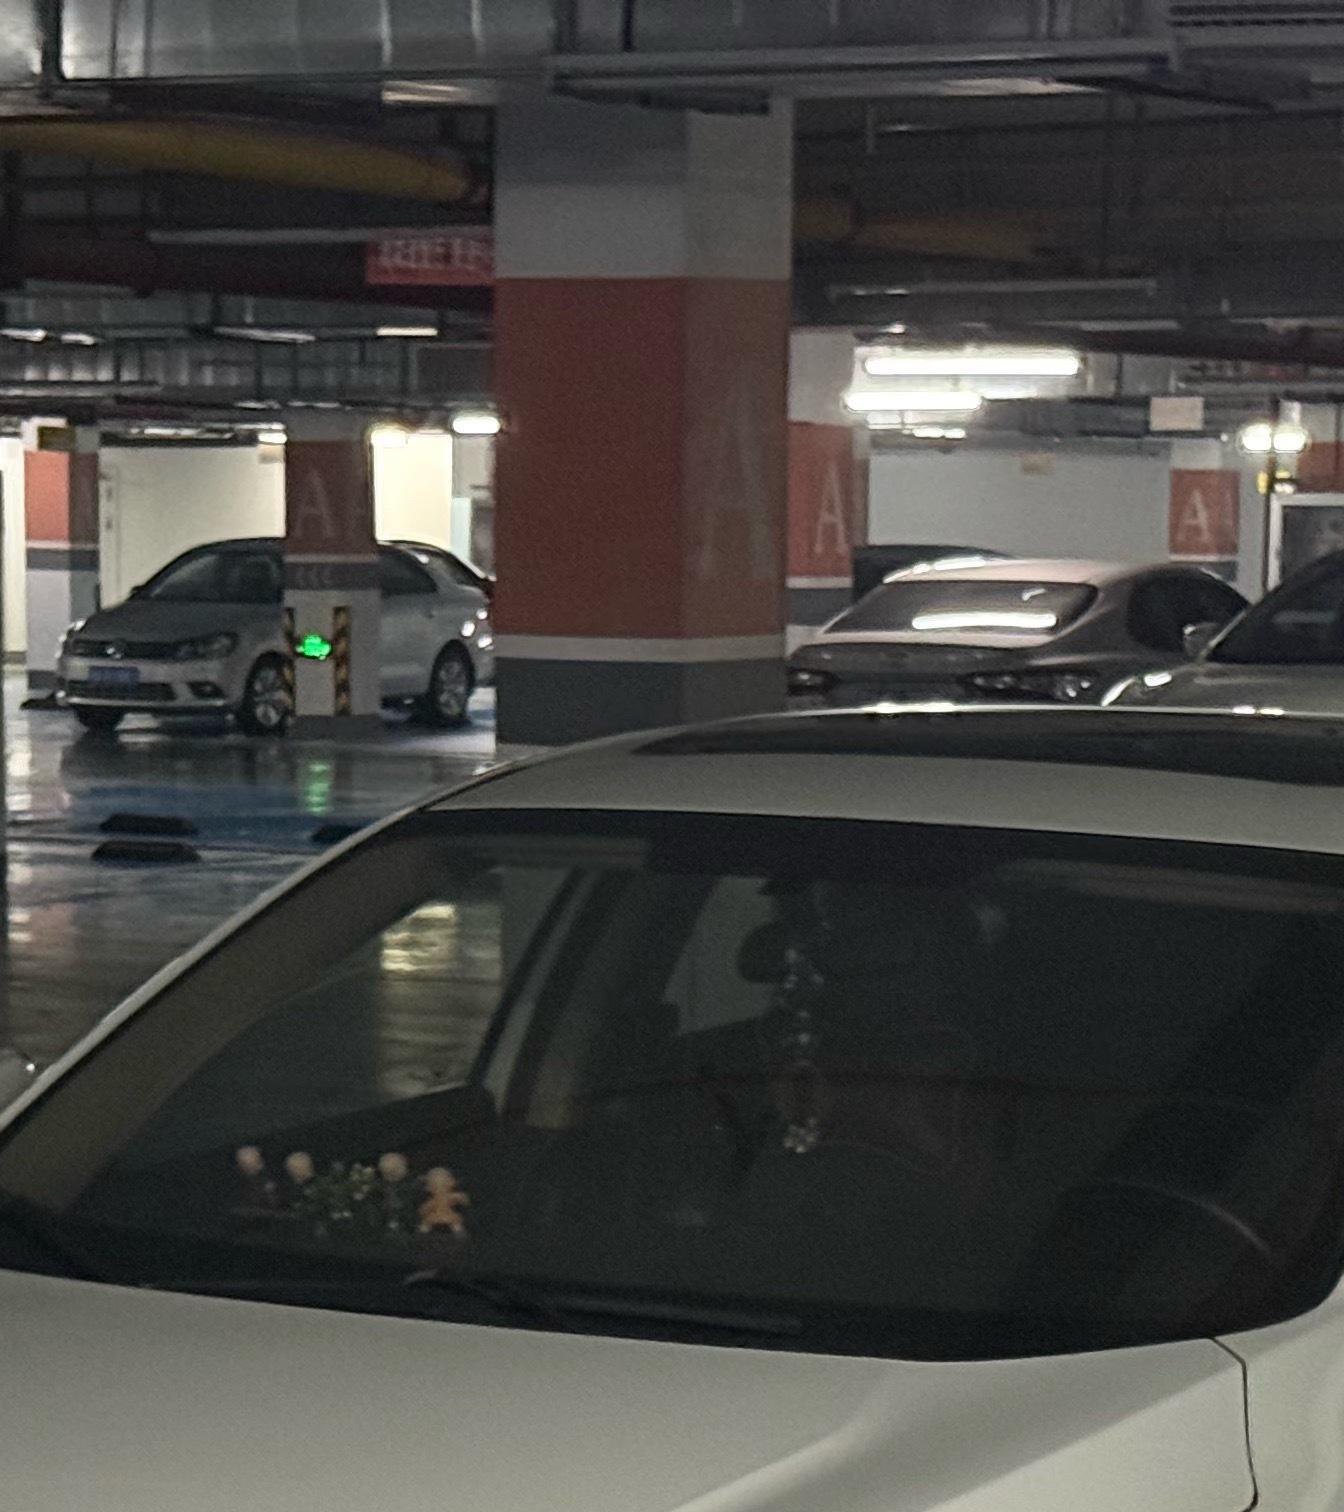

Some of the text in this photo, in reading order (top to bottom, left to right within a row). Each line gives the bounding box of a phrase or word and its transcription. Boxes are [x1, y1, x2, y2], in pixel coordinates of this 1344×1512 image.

[292, 467, 335, 538] A
[815, 463, 847, 554] A
[1178, 488, 1212, 543] A
